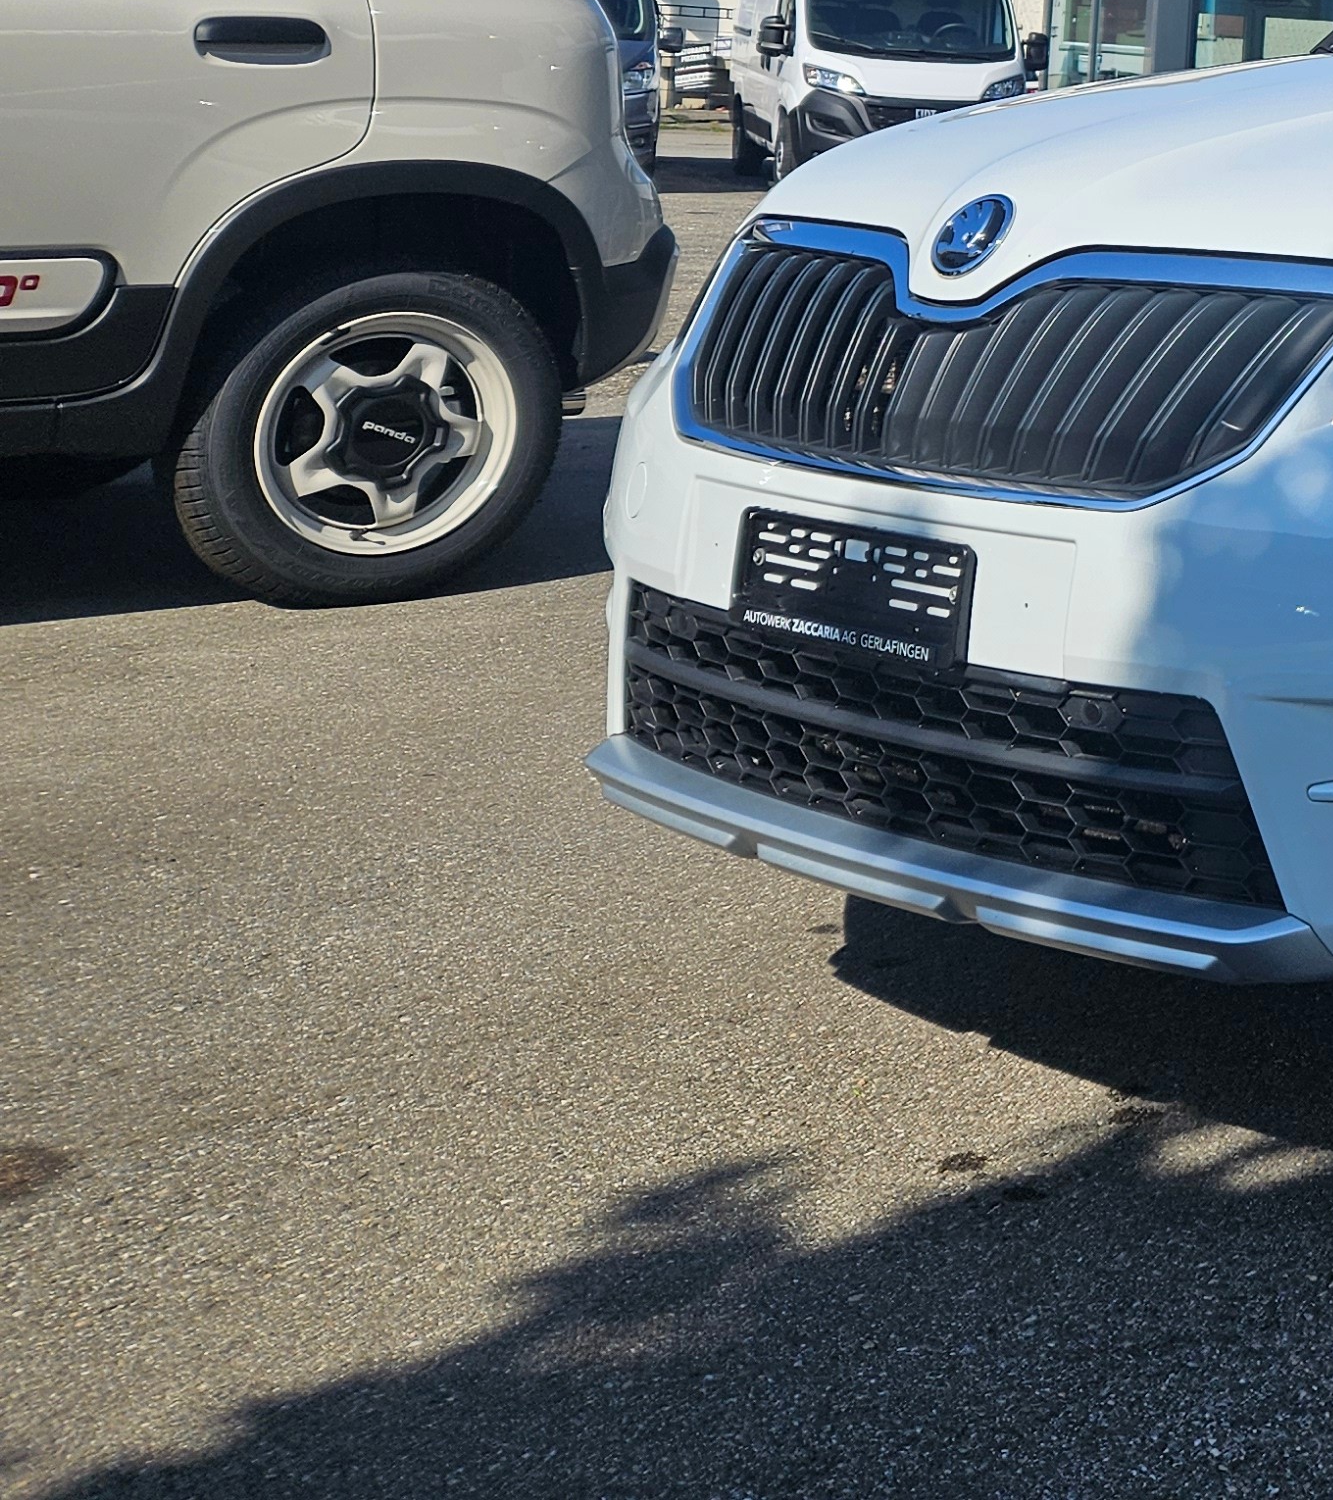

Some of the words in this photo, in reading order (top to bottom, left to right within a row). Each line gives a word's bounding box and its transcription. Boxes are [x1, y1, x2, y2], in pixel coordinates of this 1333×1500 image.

[362, 421, 416, 444] panda
[743, 609, 792, 631] AUTOWERK
[791, 618, 840, 642] ZACCARIA
[841, 631, 857, 646] AG
[860, 633, 930, 662] GERLAFINGEN
